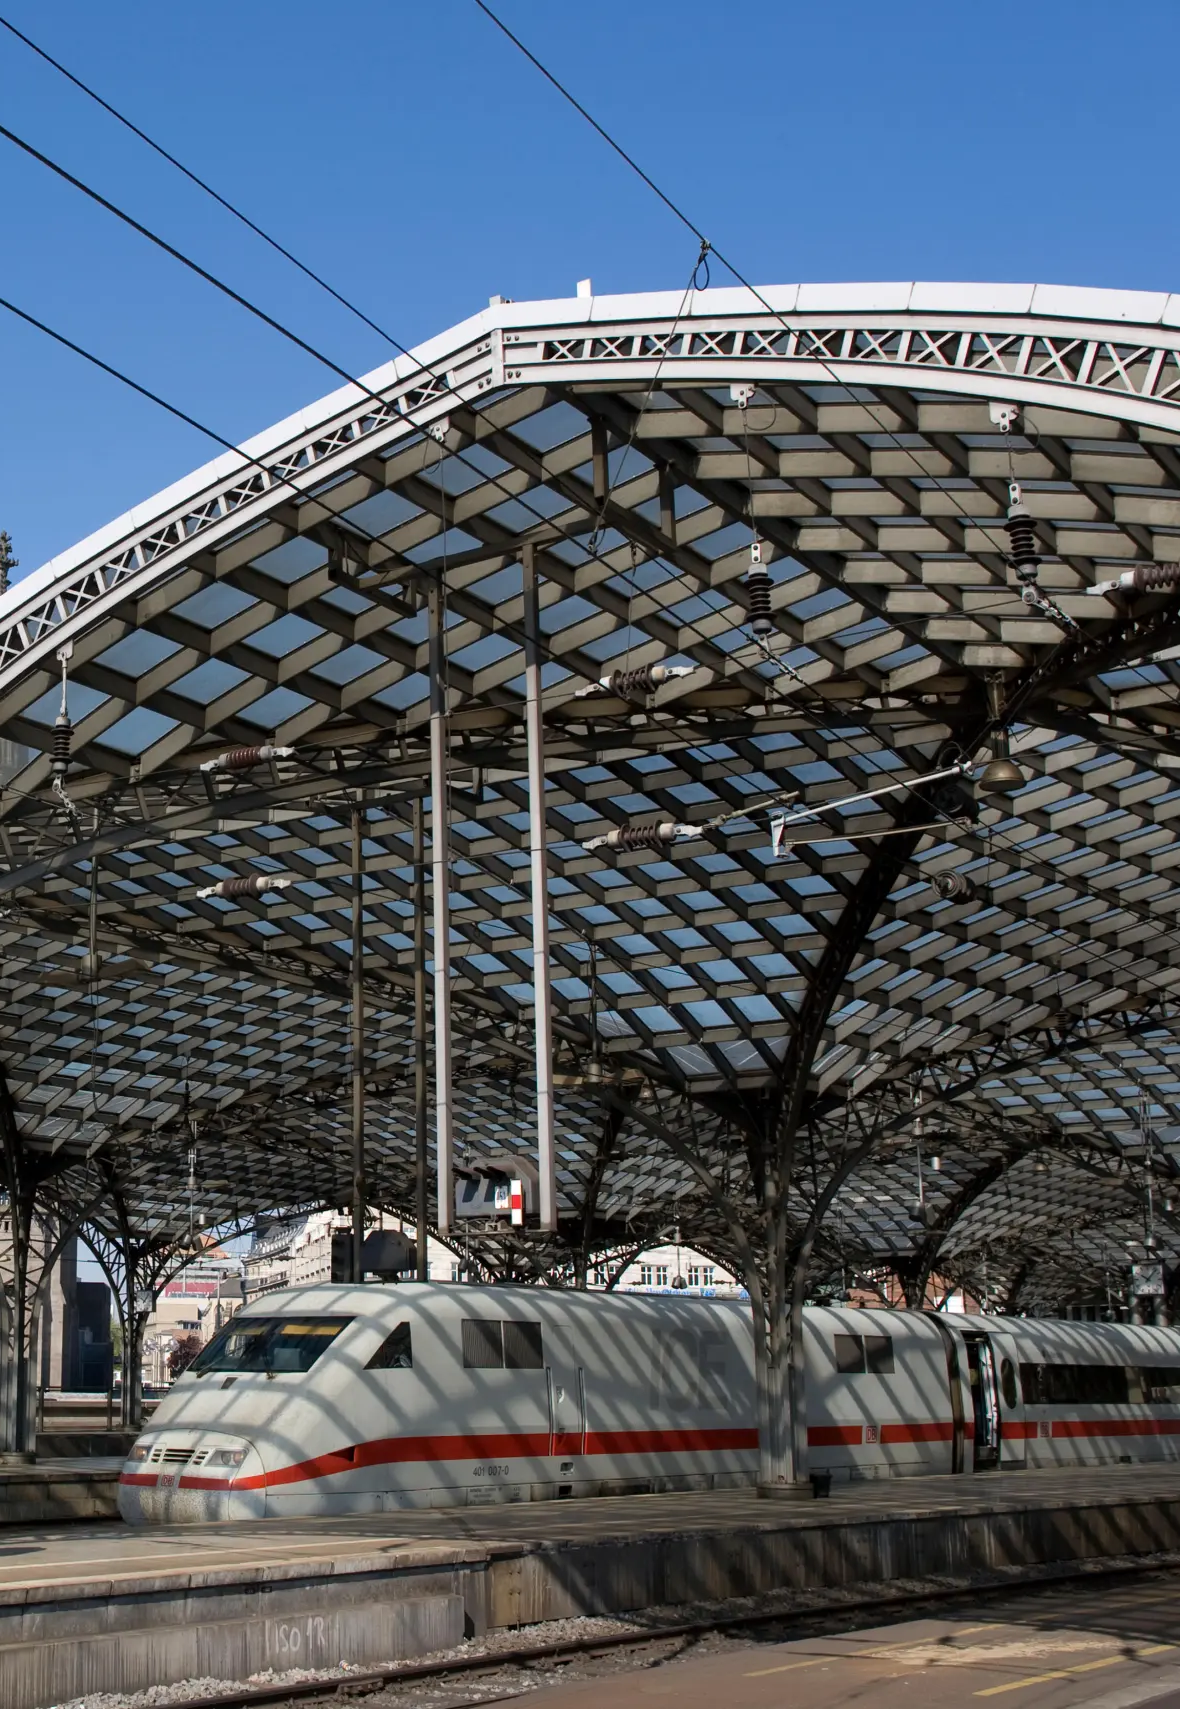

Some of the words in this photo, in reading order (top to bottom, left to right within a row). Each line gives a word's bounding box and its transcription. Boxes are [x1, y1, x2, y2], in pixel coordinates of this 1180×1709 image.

[649, 1328, 728, 1412] ICE
[866, 1427, 877, 1442] DB
[473, 1466, 484, 1476] 401
[488, 1465, 509, 1476] 007-0
[162, 1476, 173, 1486] DB
